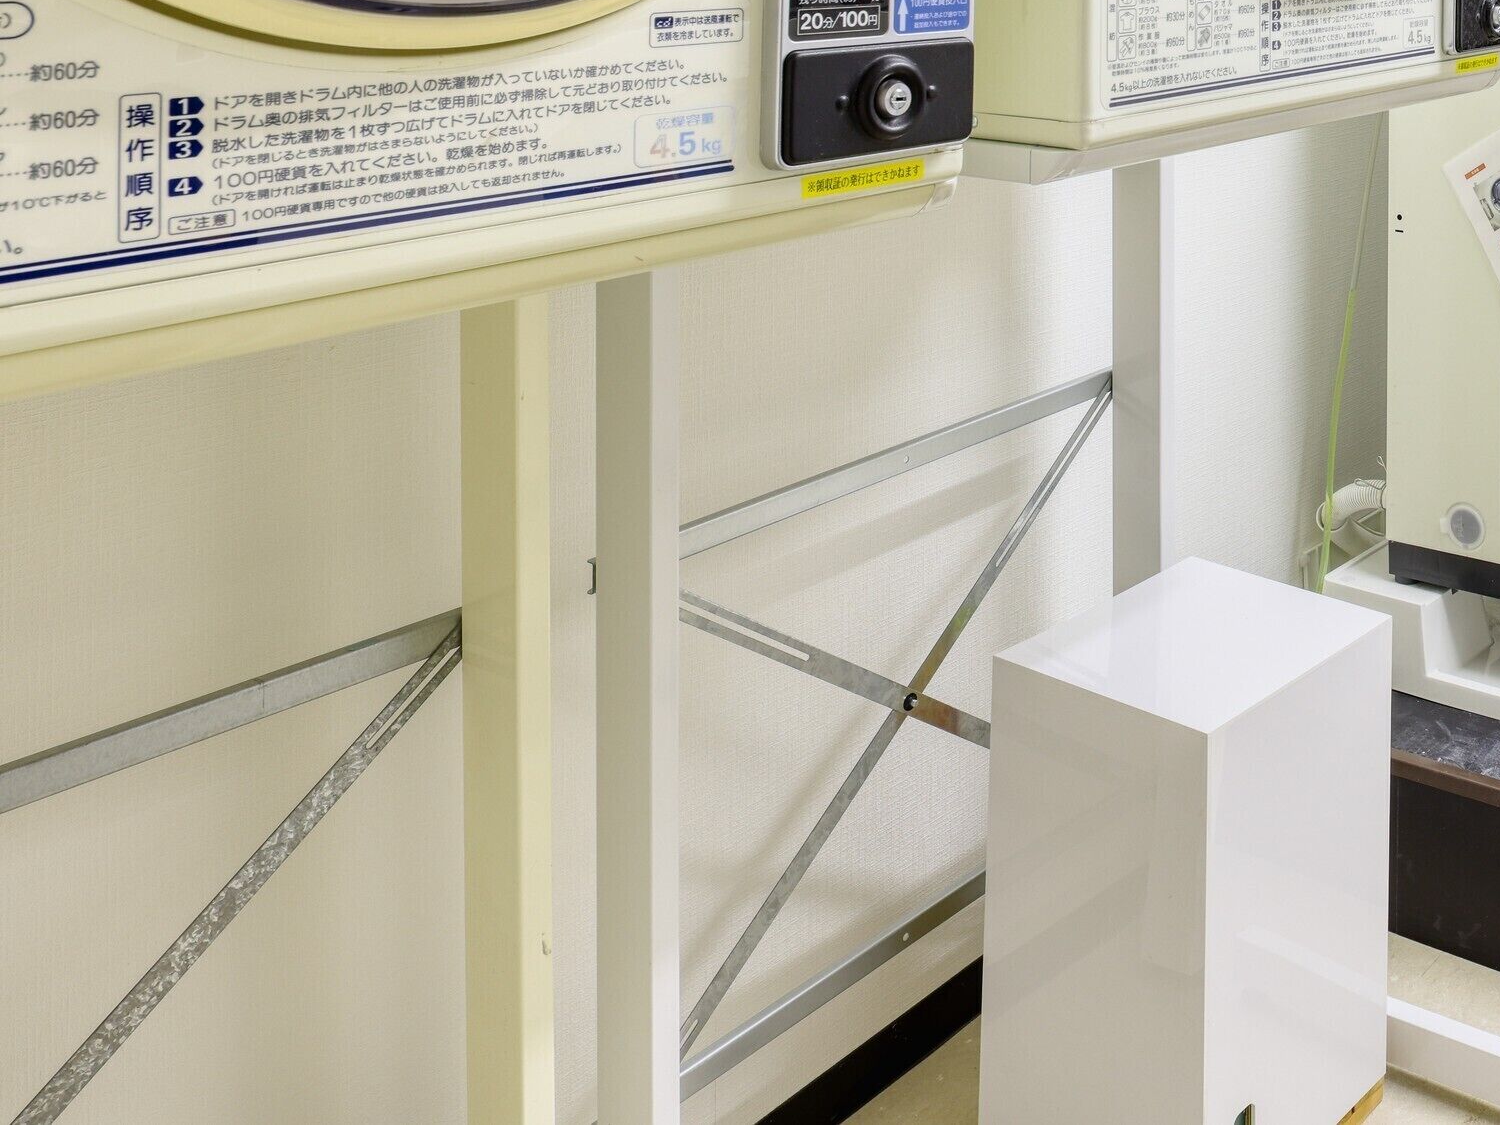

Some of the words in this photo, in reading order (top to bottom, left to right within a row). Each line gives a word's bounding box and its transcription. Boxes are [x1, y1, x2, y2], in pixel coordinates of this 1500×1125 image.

[800, 10, 878, 31] 20分/100円
[657, 28, 733, 42] 衣類を冷ましています。
[29, 61, 100, 82] 約60分
[29, 109, 100, 131] 約60分
[29, 157, 99, 180] 約60分
[124, 103, 156, 231] 操作順序
[177, 213, 228, 232] ご注意
